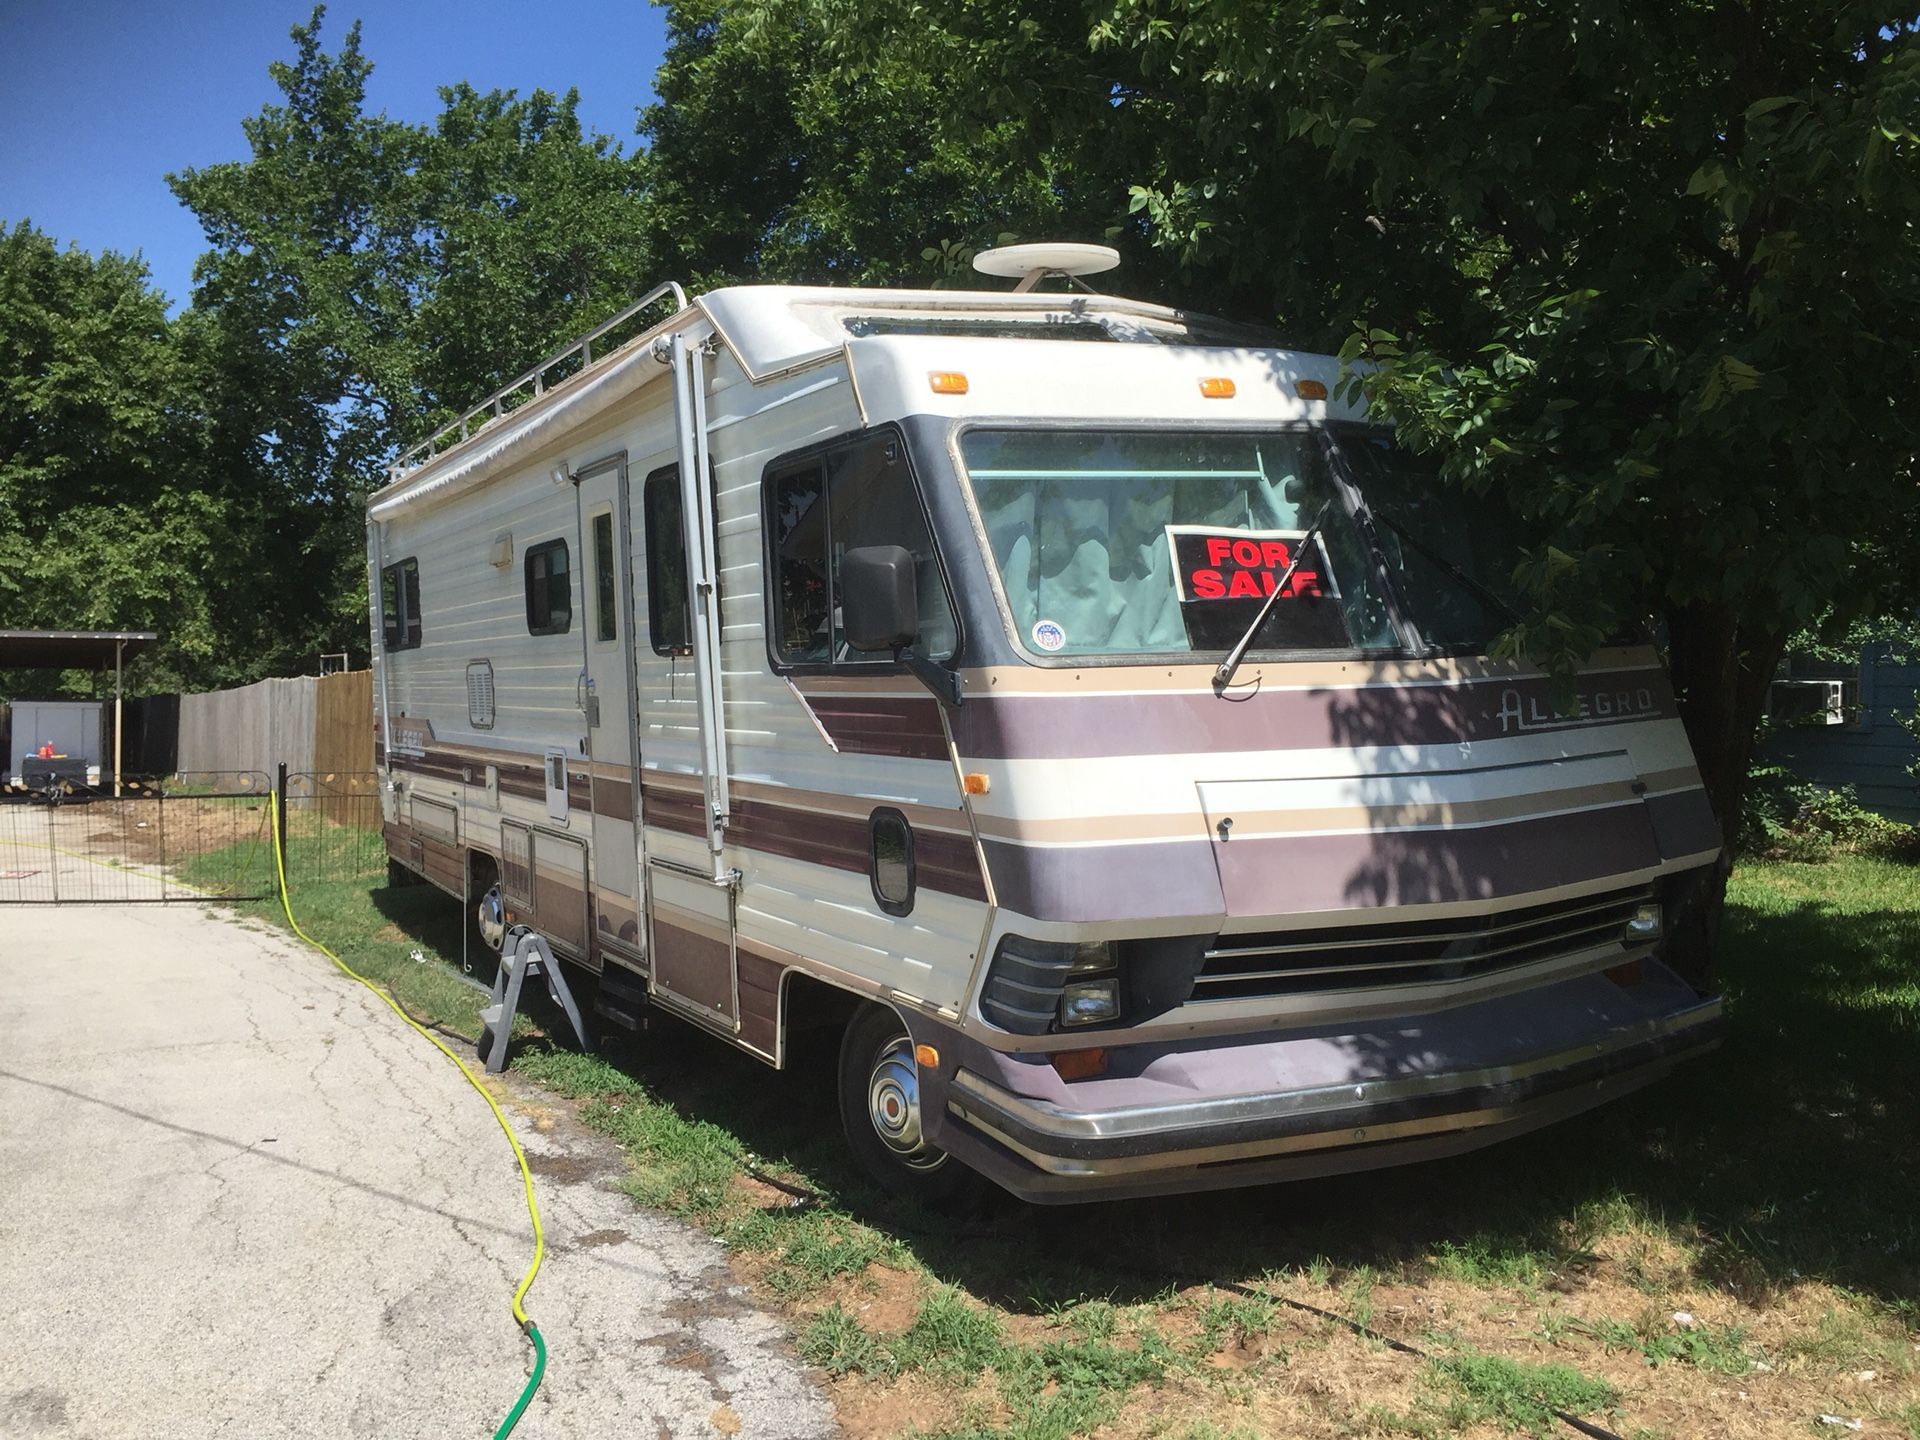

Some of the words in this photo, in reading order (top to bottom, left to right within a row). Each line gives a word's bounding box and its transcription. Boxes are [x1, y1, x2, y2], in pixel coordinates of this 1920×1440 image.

[1206, 538, 1291, 568] FOR
[1191, 569, 1322, 598] SALE
[1496, 688, 1654, 732] ALEGRO
